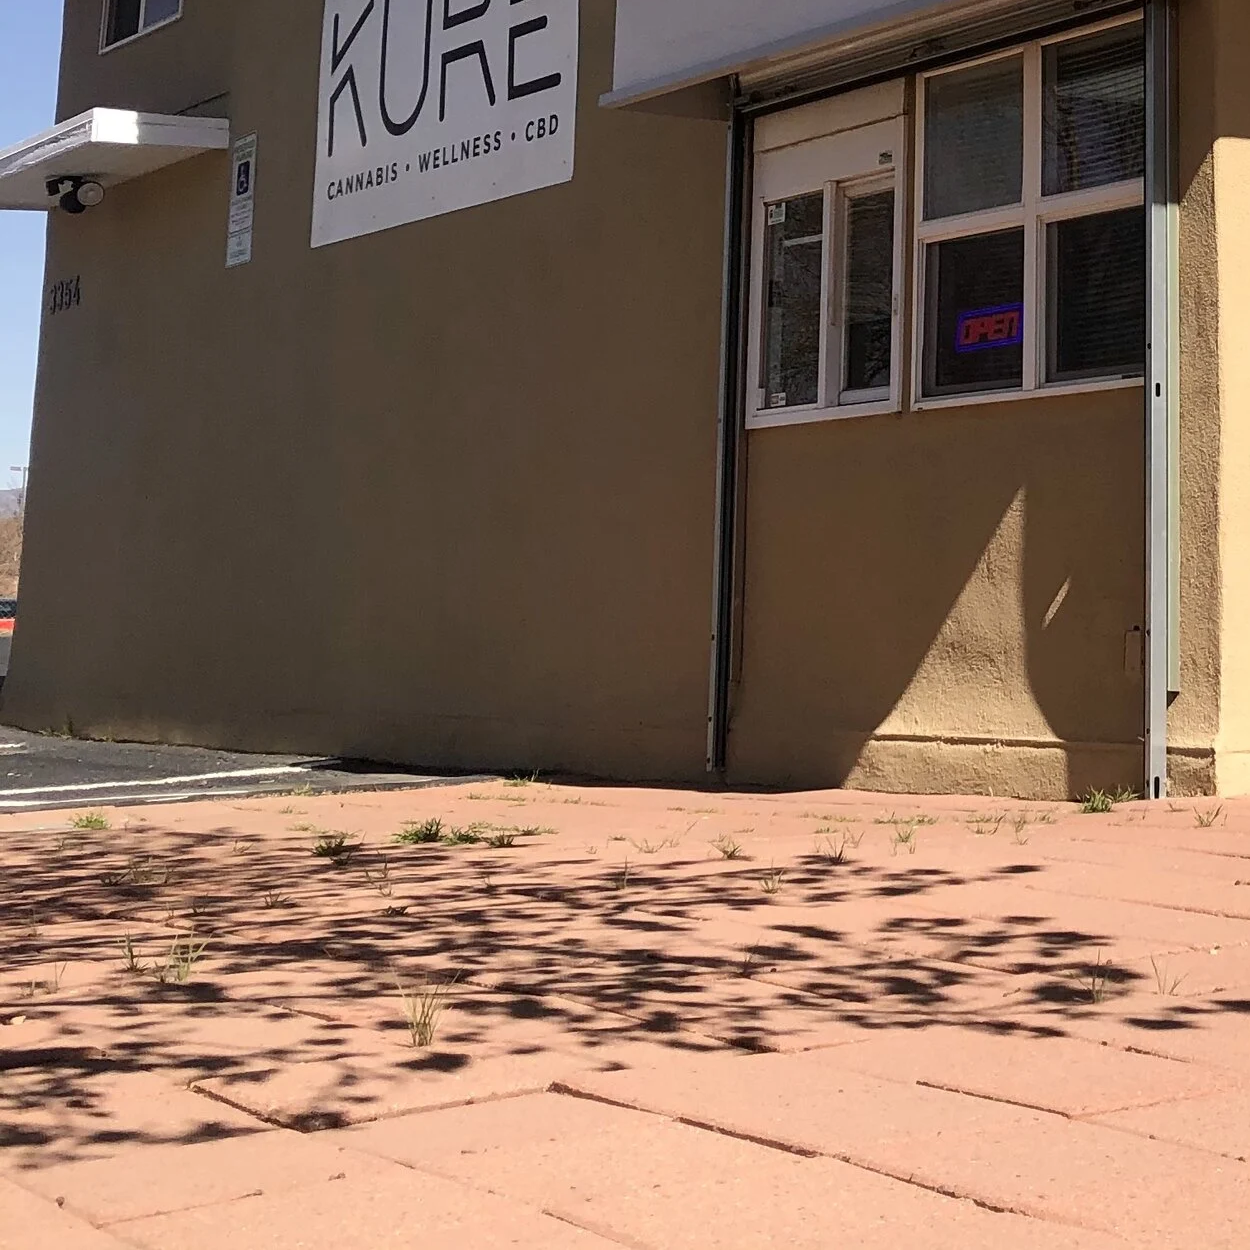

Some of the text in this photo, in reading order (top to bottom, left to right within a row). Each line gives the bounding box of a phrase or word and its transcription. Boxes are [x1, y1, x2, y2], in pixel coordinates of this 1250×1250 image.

[327, 114, 560, 200] CANNABIS WELLNESS CBD
[960, 311, 1020, 345] OPEN
